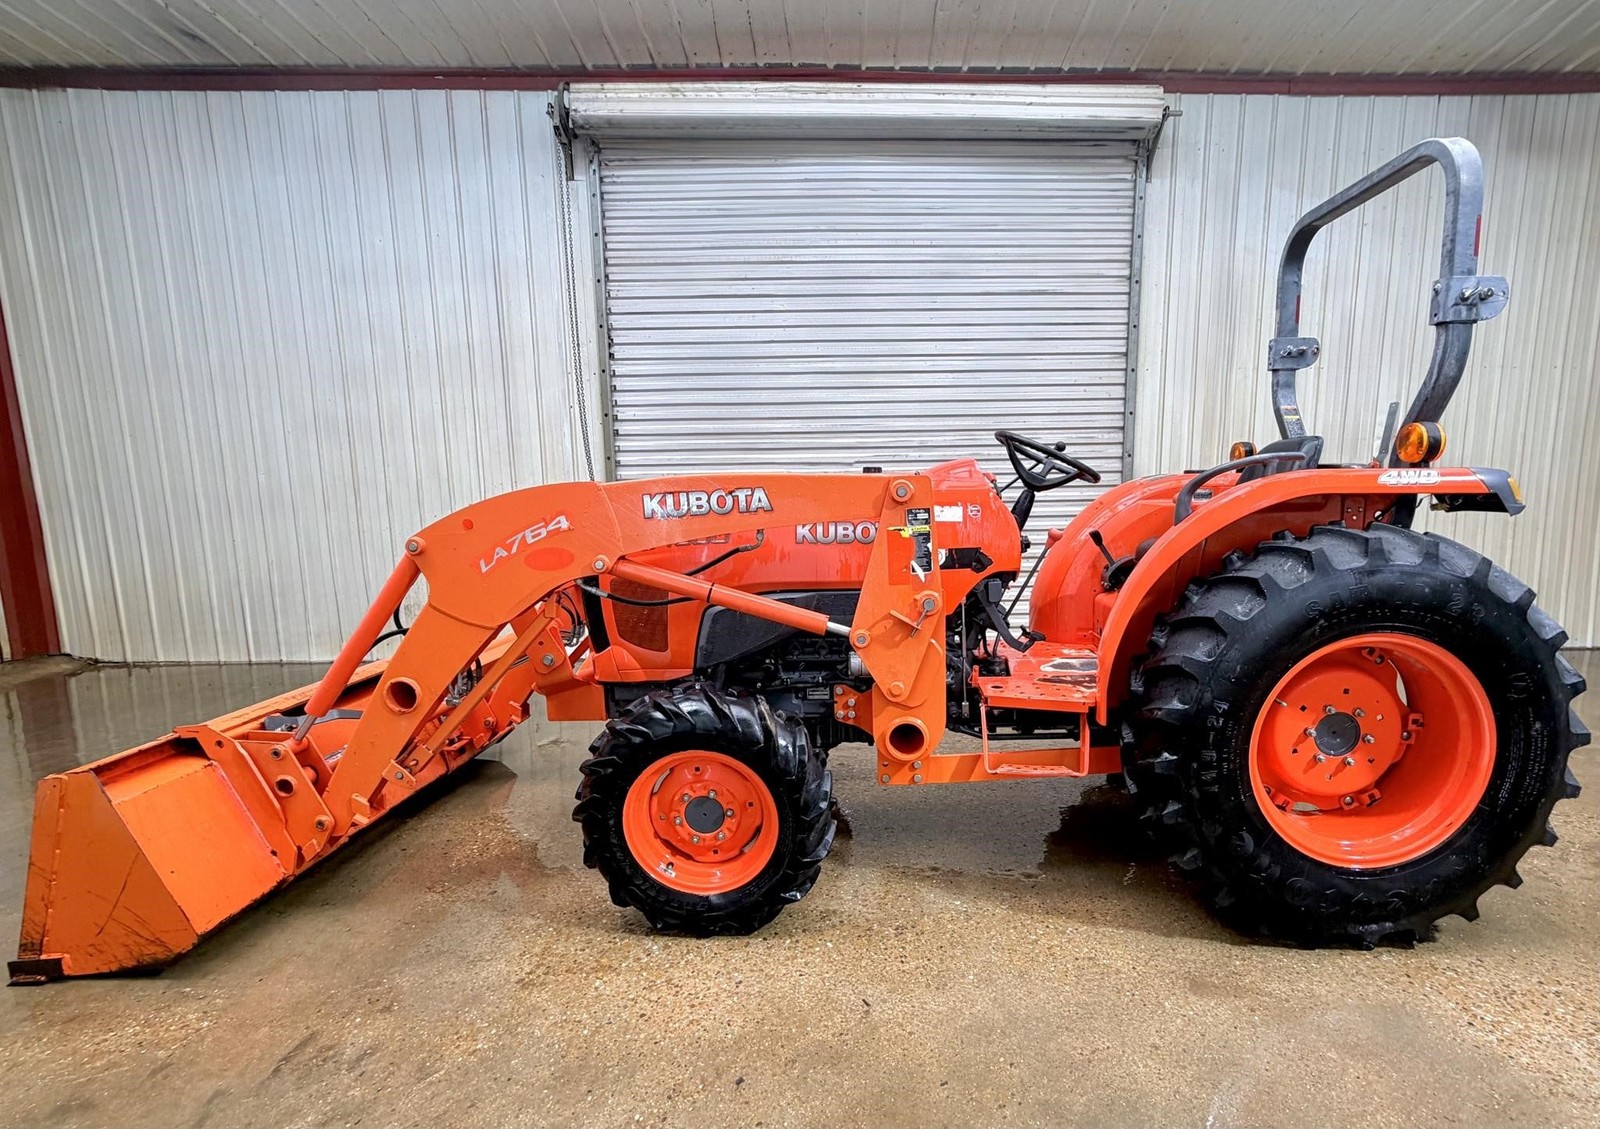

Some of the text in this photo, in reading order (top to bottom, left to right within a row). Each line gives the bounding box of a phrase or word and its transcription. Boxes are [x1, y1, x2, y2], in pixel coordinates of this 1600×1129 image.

[1378, 469, 1440, 485] 4WD
[642, 486, 774, 519] KUBOTA
[480, 515, 572, 573] LA764
[795, 521, 879, 544] KUBO
